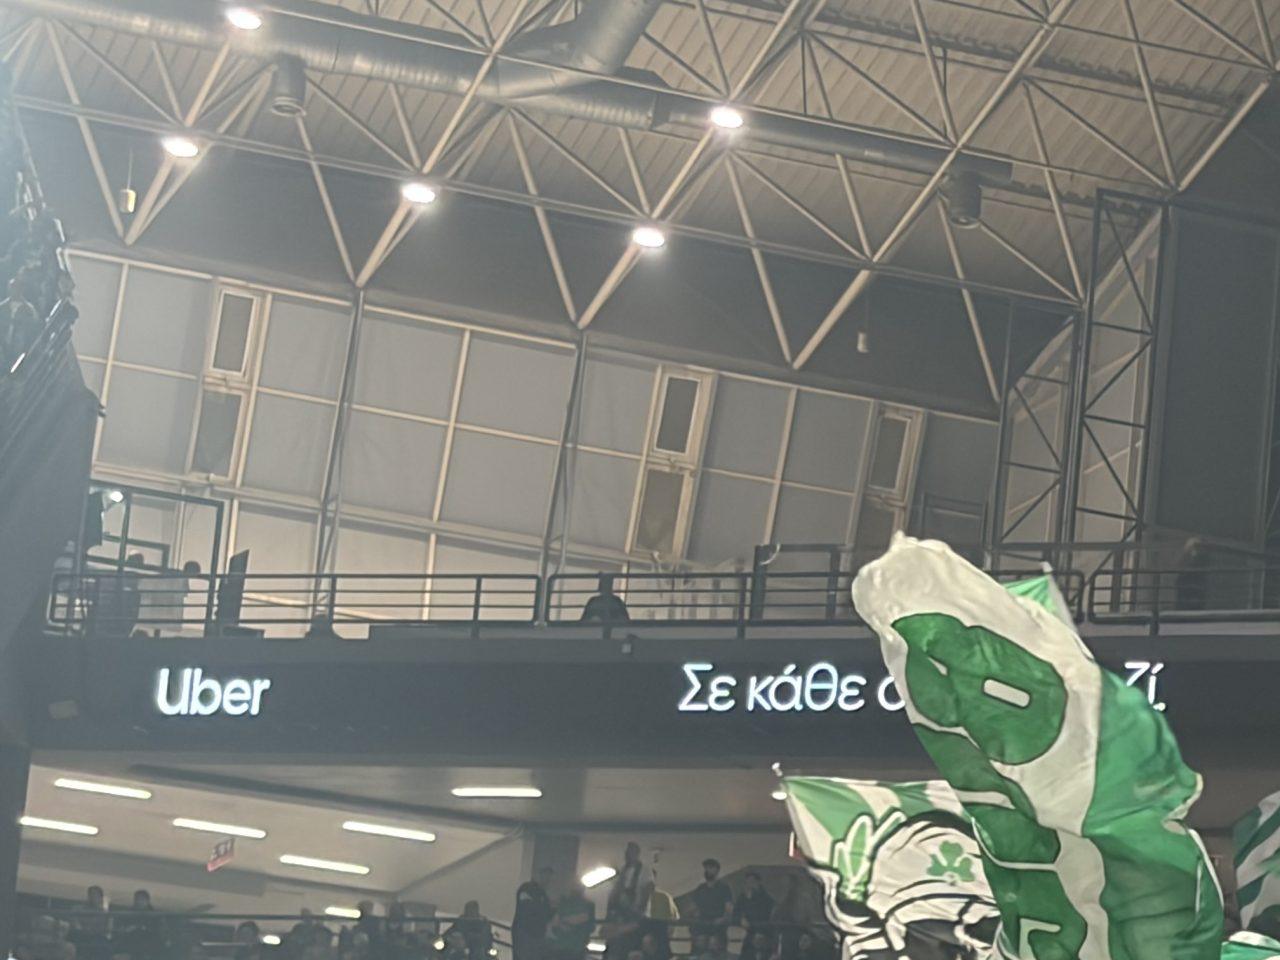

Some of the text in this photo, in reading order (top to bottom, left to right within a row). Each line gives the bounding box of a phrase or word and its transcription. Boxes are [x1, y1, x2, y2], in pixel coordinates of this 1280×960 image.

[156, 667, 271, 716] Uber
[678, 663, 737, 711] Σε
[747, 662, 867, 711] κάθε
